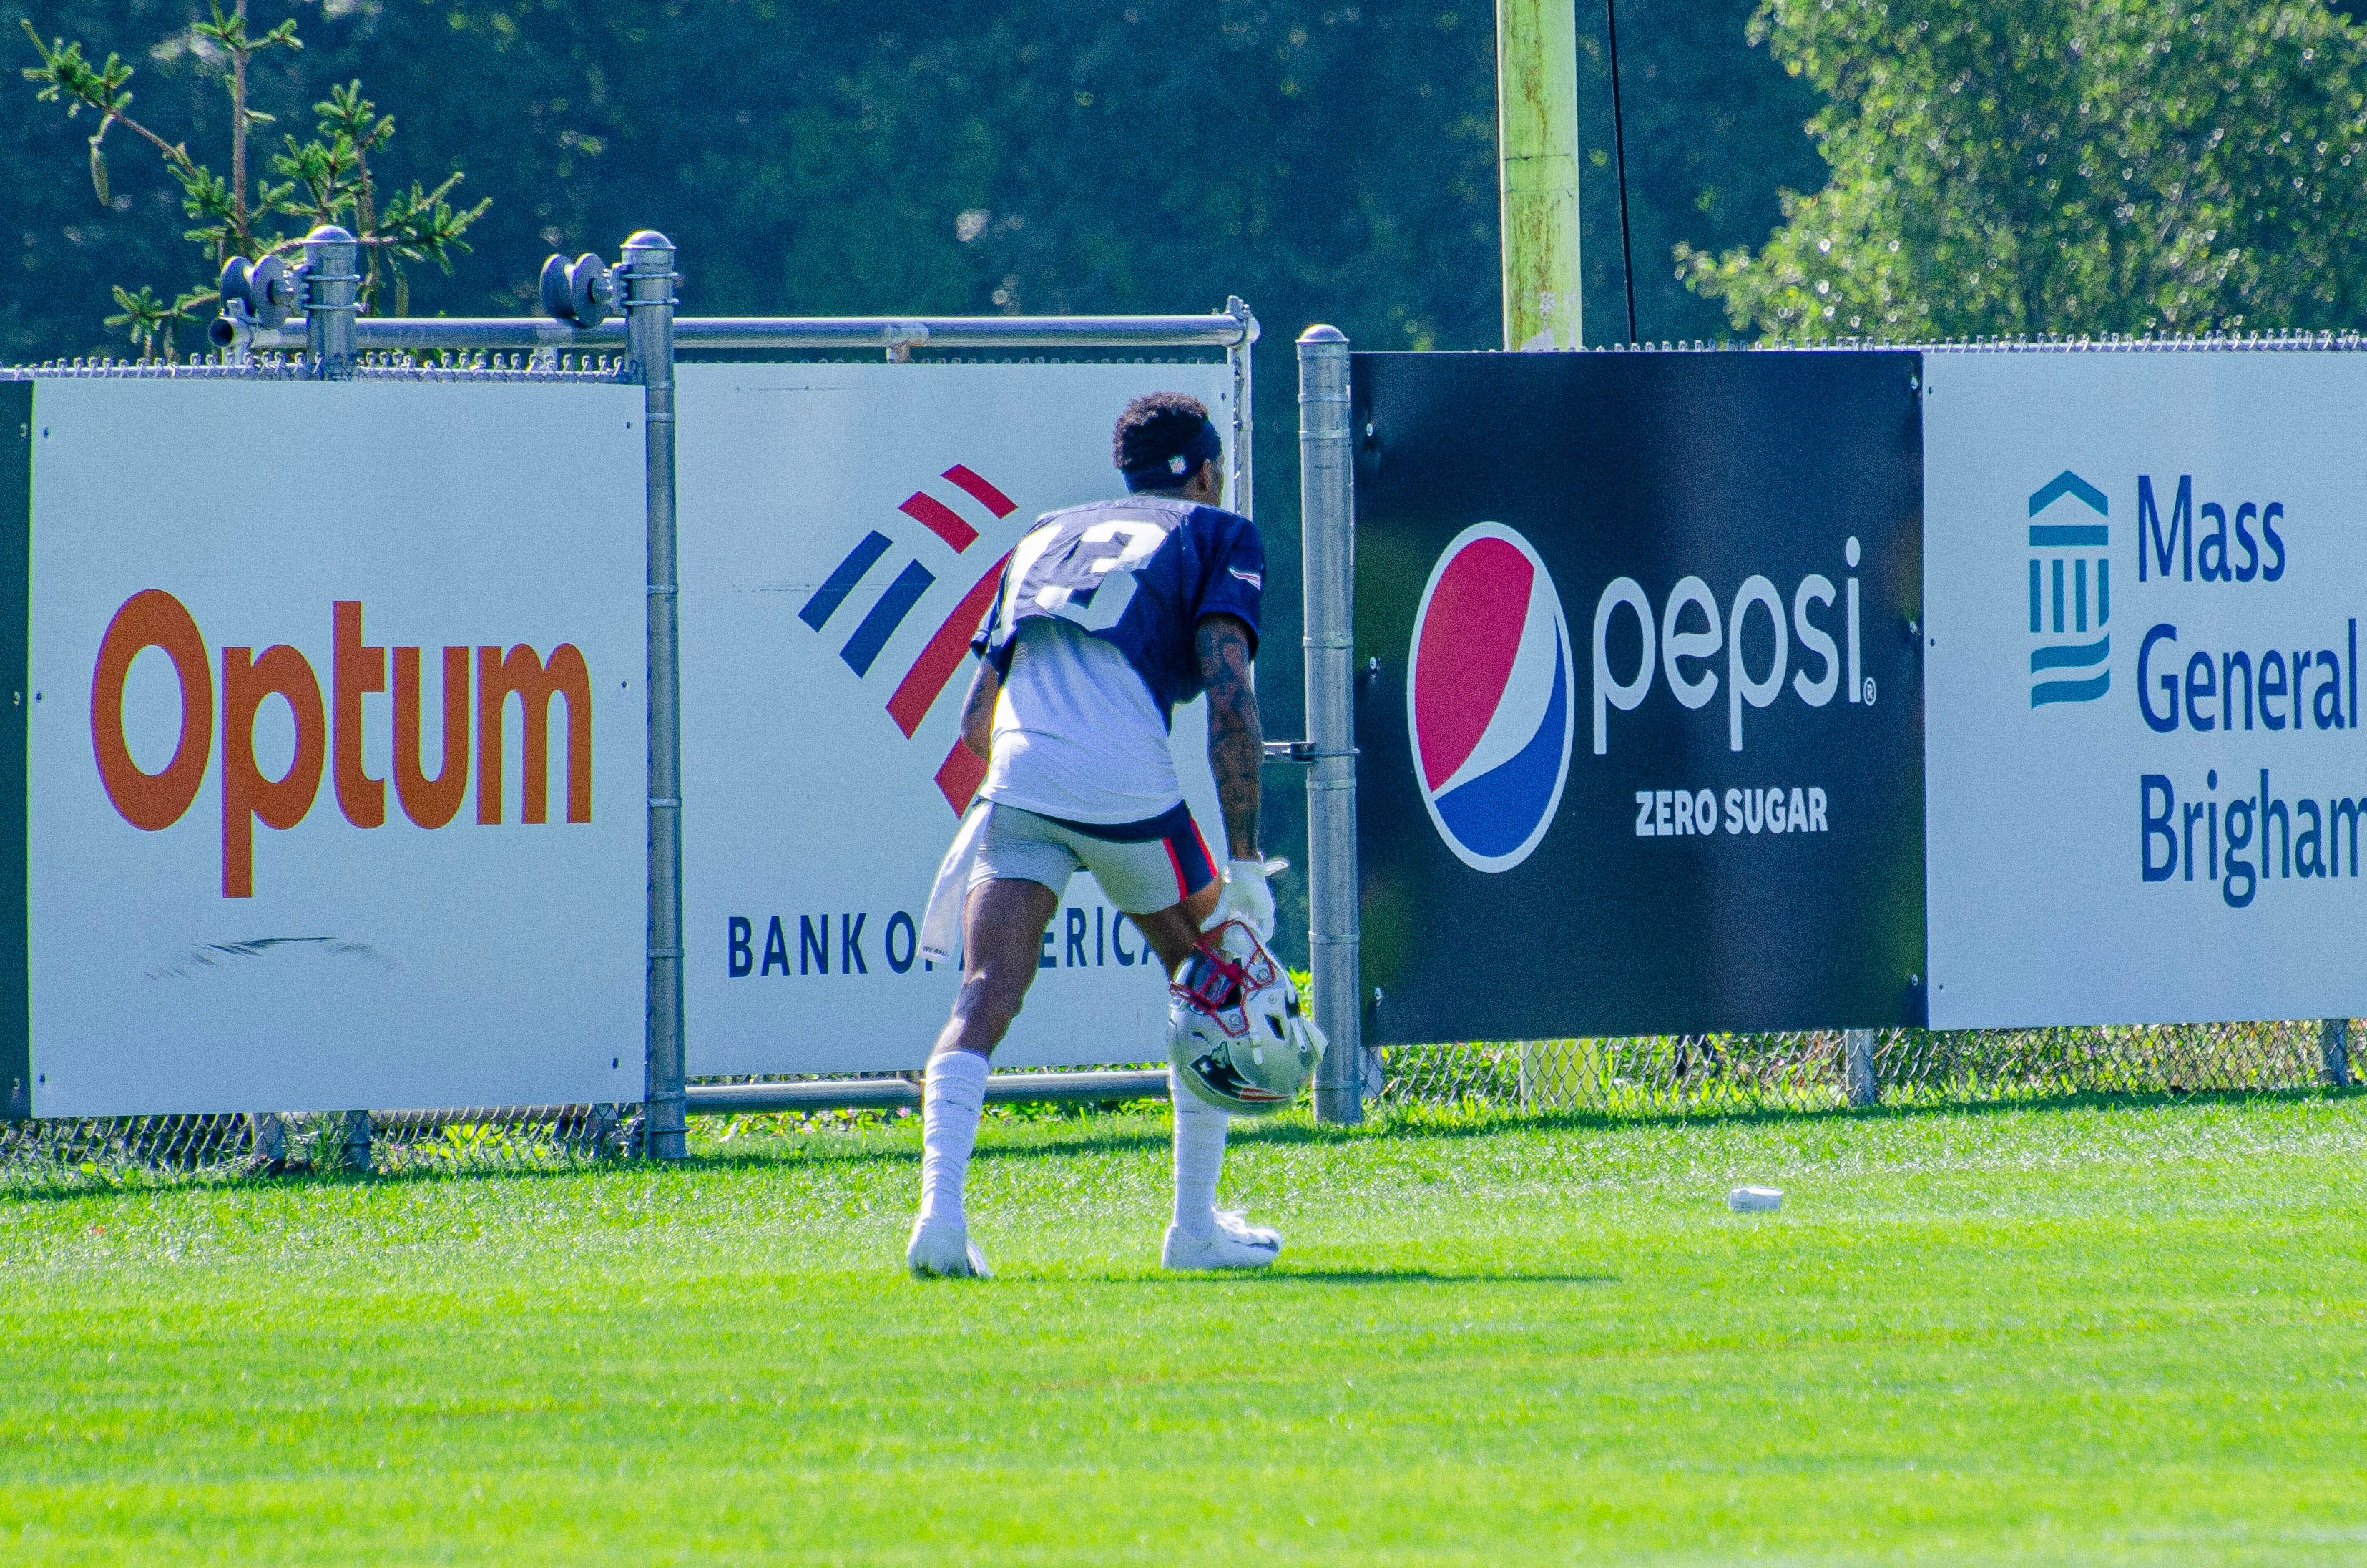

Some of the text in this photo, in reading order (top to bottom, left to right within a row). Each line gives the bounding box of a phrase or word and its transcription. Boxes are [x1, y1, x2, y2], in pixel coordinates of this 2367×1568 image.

[991, 520, 1167, 647] 13
[2137, 474, 2285, 582] Mass
[2137, 618, 2358, 733] General
[91, 589, 592, 898] Optum
[1635, 787, 1828, 836] ZERO SUGAR
[728, 913, 868, 978] BANK
[885, 911, 933, 974] O
